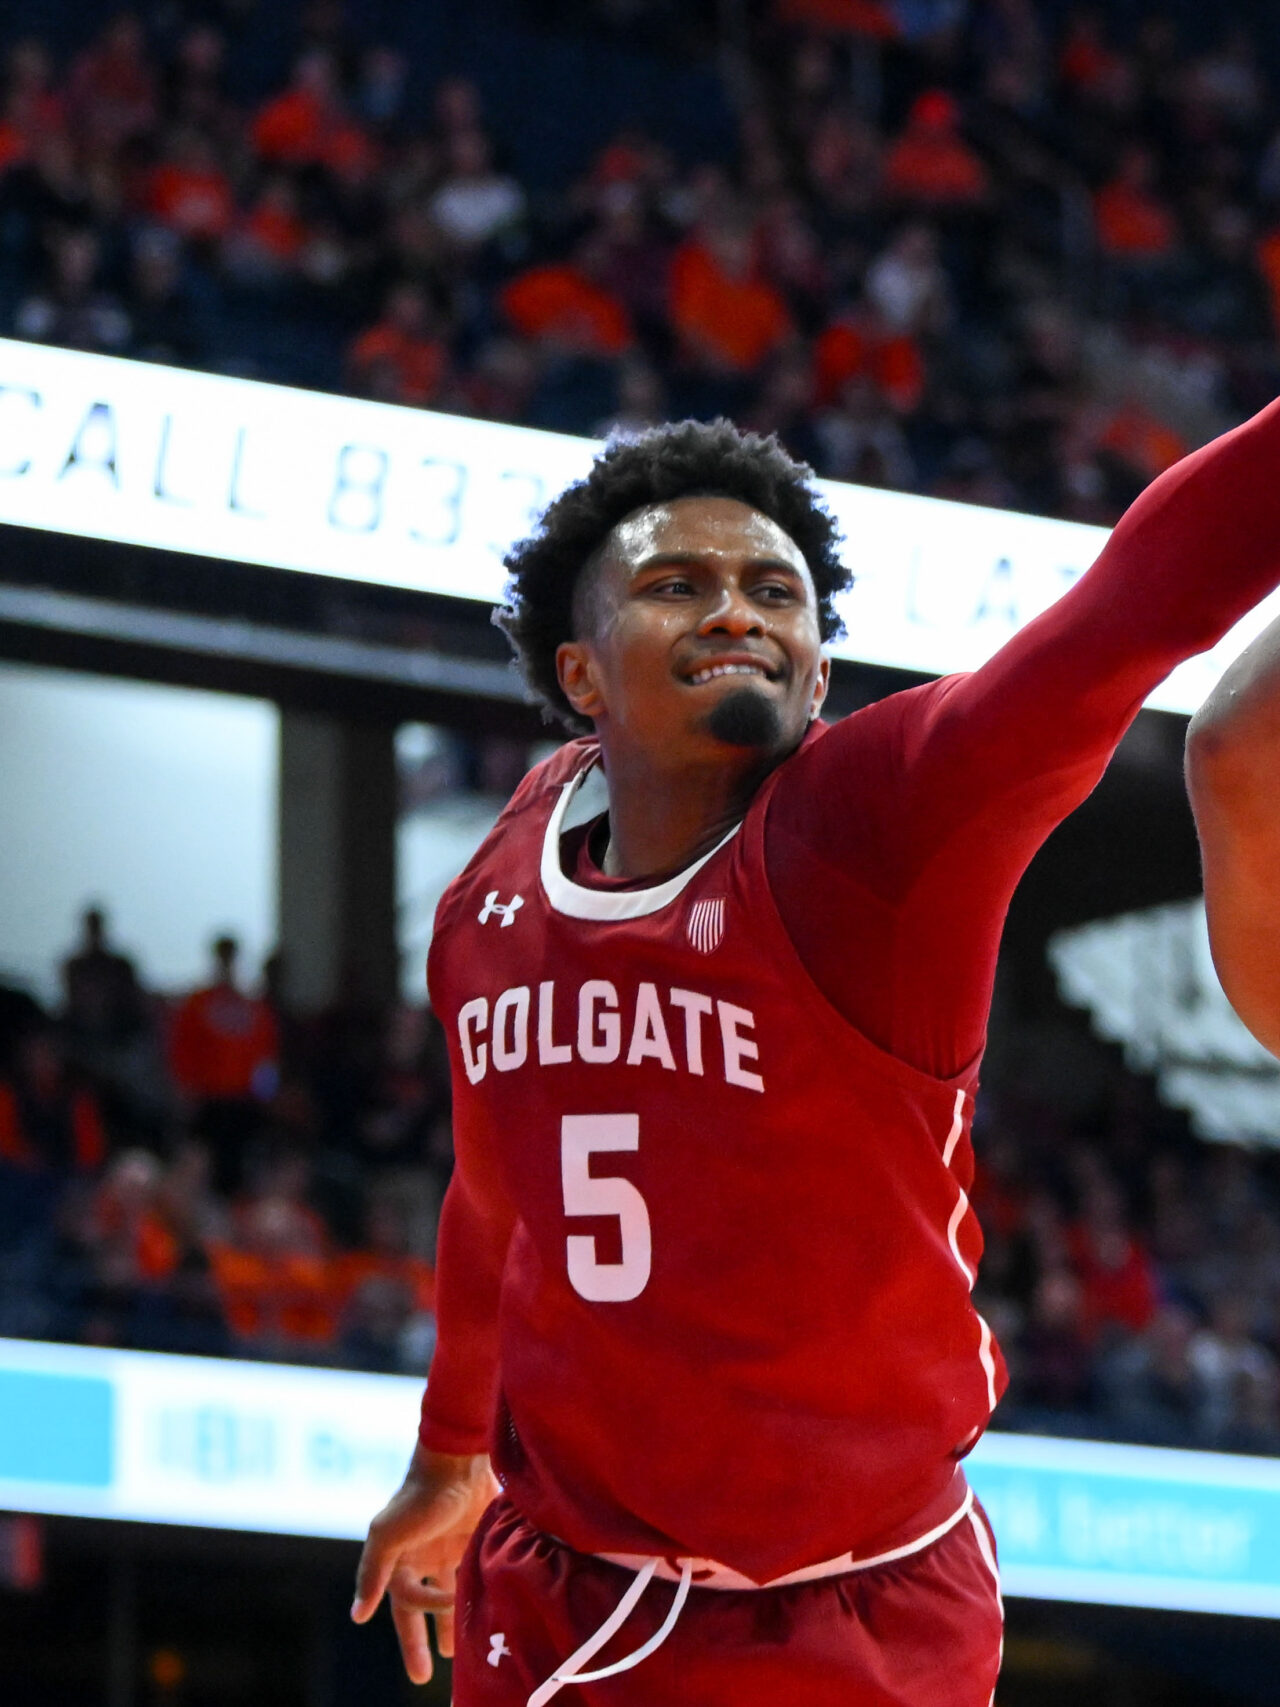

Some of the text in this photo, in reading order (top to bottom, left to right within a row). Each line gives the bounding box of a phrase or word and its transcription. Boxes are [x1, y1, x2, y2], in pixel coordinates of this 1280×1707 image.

[0, 383, 267, 519] CALL
[458, 980, 764, 1093] COLGATE
[561, 1113, 652, 1302] 5
